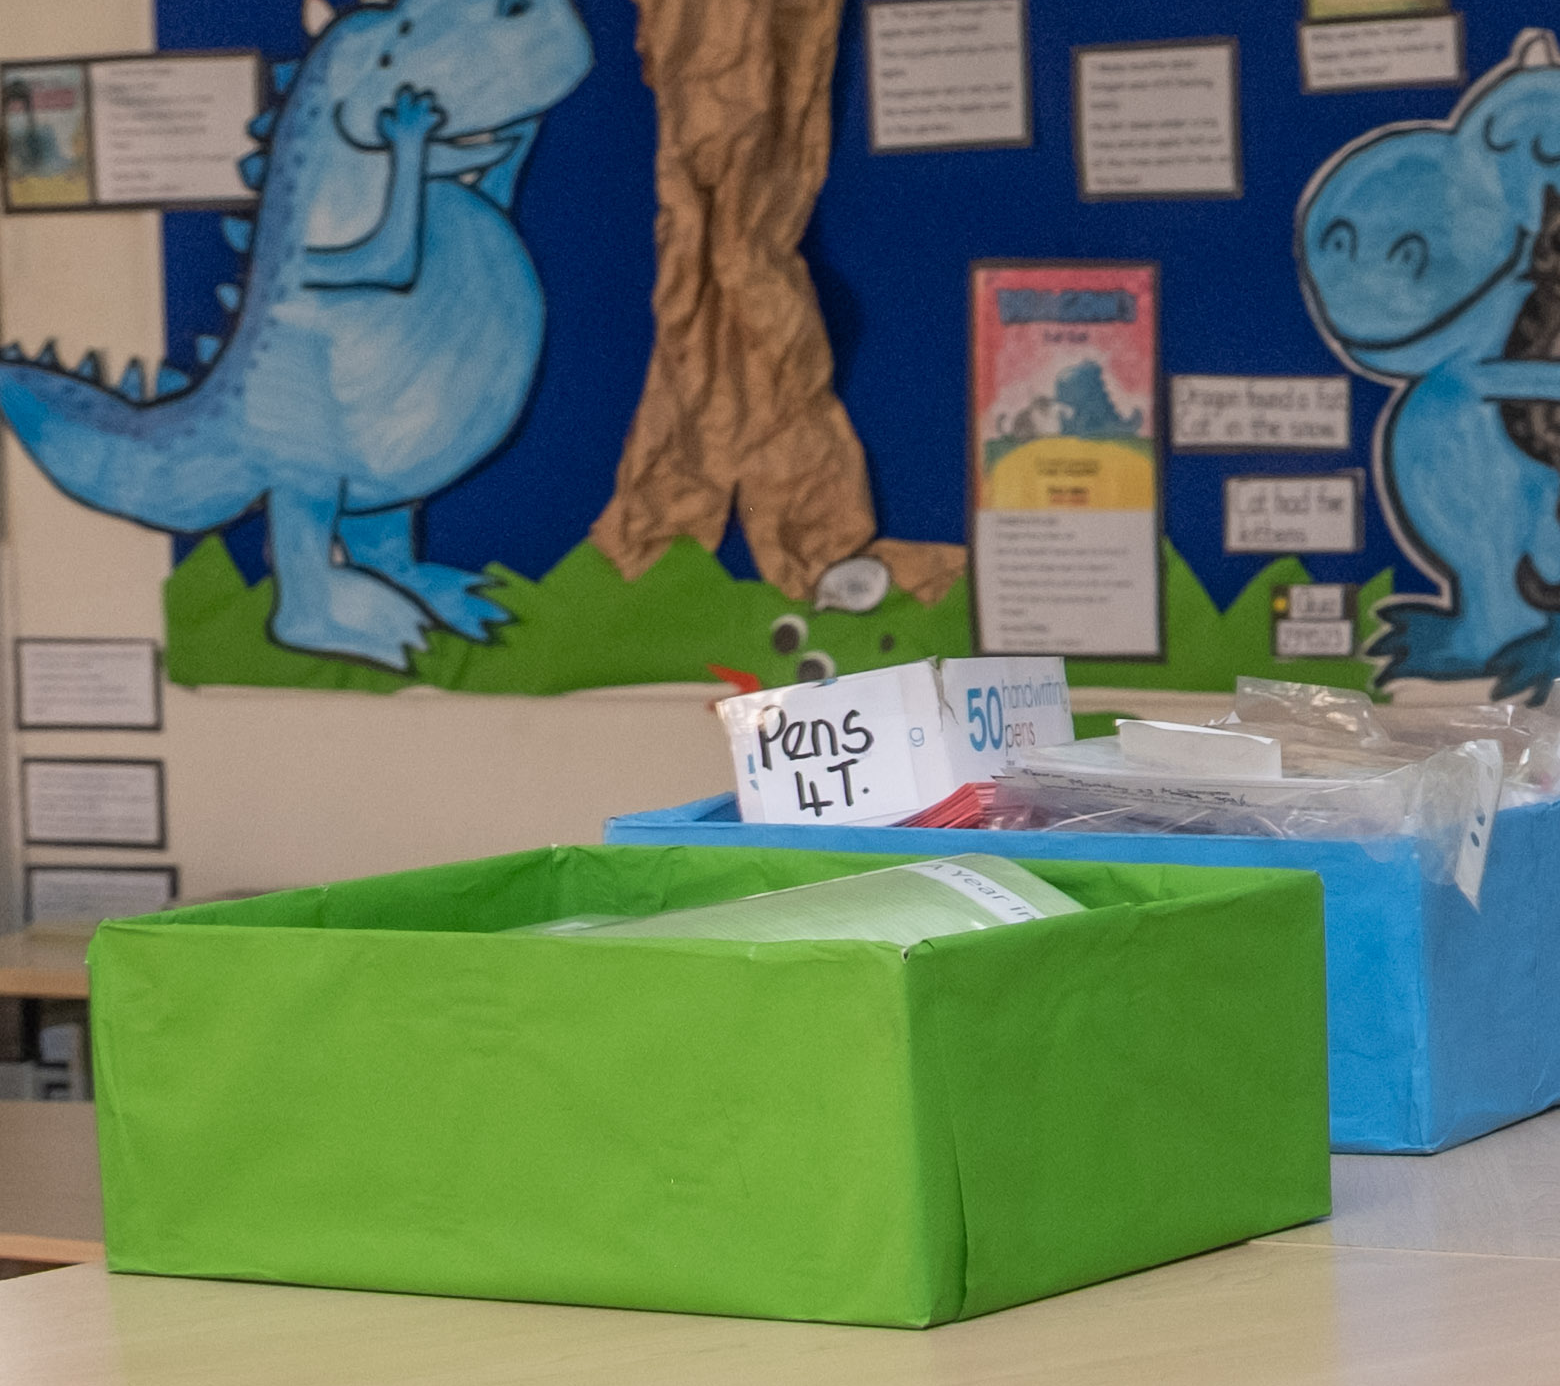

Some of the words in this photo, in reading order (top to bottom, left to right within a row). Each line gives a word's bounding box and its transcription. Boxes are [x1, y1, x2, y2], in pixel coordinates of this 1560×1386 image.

[757, 704, 874, 770] Pens
[966, 685, 1005, 753] 50
[1002, 674, 1070, 712] handwriting
[1004, 718, 1036, 756] pens
[951, 865, 1012, 905] Year
